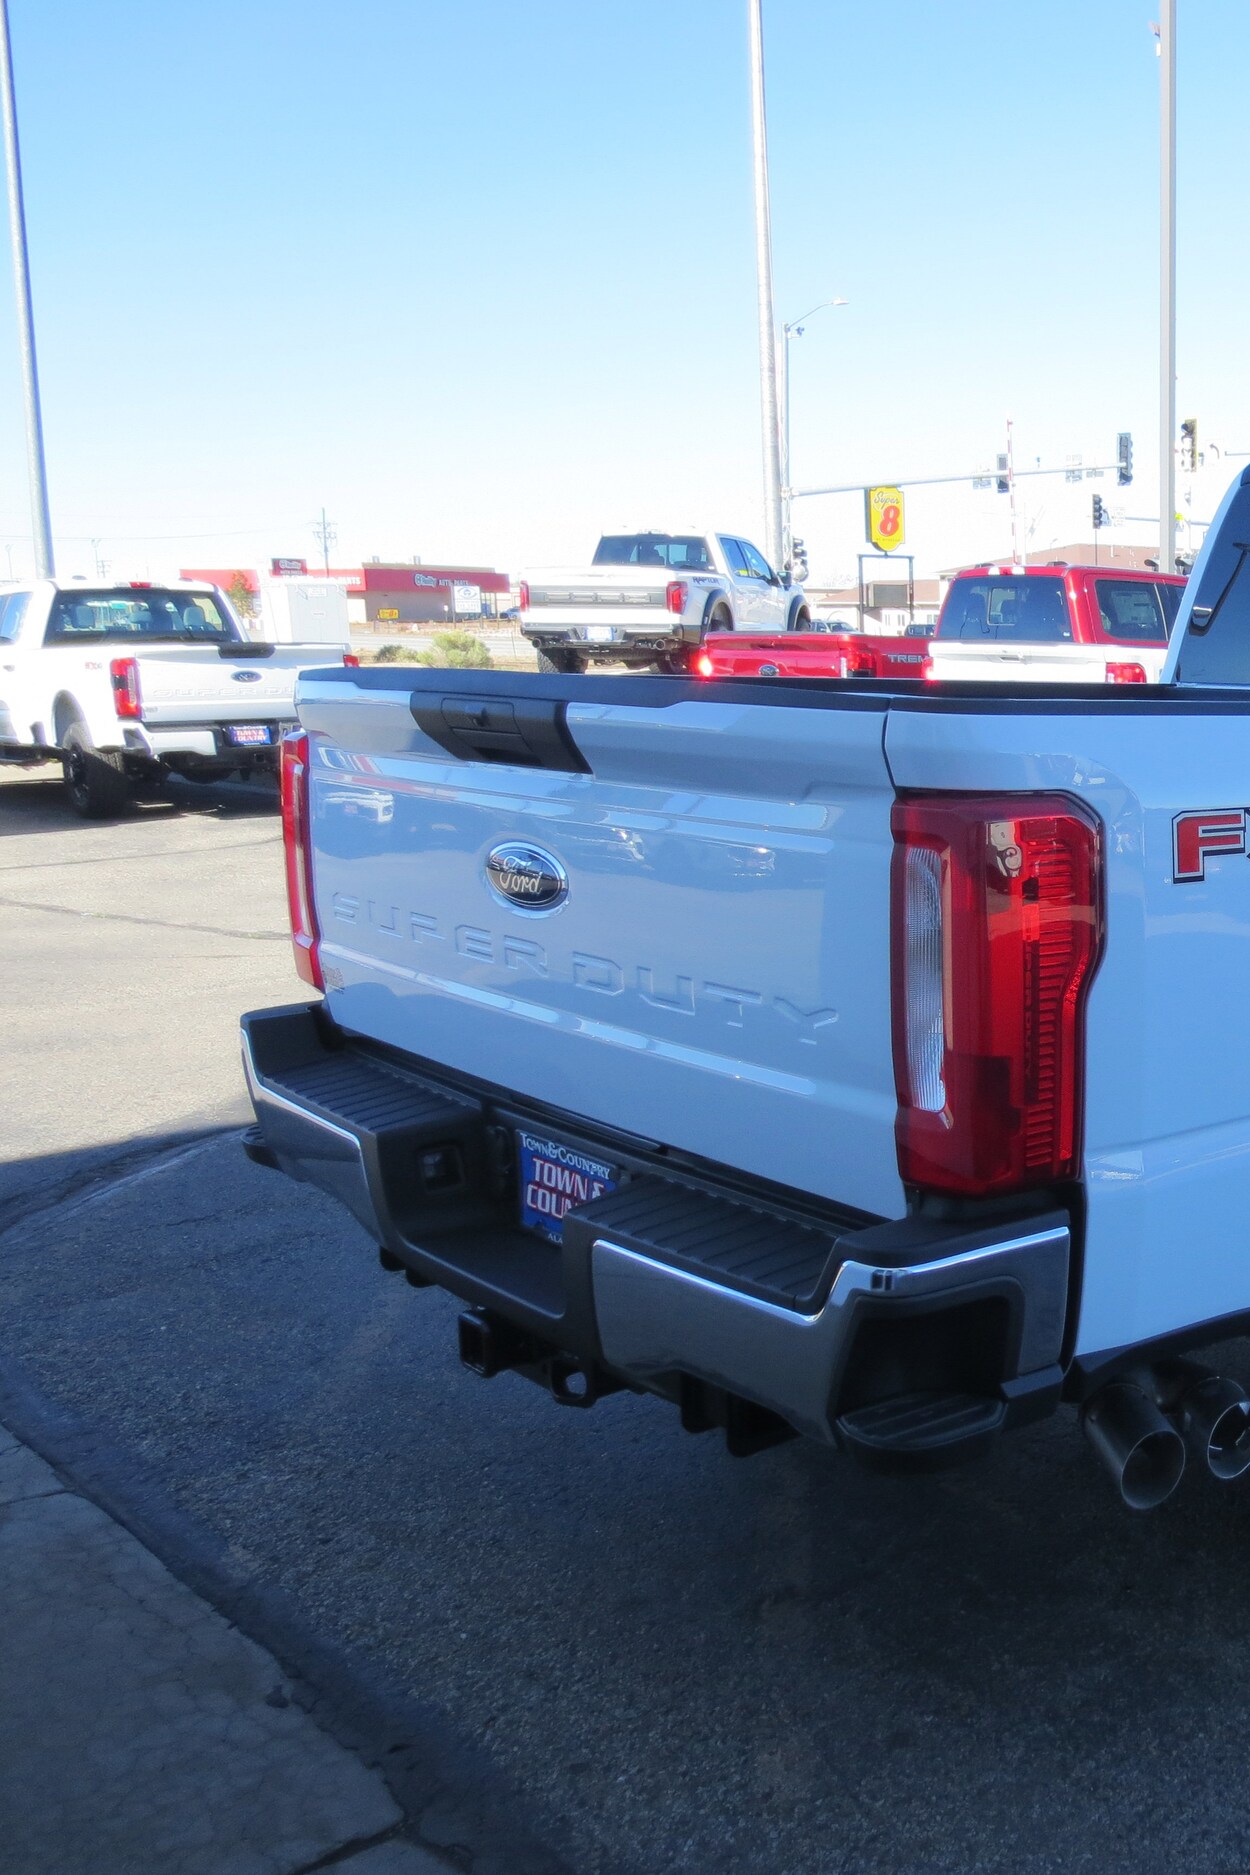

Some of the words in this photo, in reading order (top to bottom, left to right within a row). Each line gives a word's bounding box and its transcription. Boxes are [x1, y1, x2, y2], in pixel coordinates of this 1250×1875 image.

[879, 505, 900, 537] 8
[888, 654, 930, 663] TREM
[500, 855, 543, 895] Ford
[332, 891, 550, 979] SUPER
[572, 950, 839, 1045] DUTY
[532, 1157, 588, 1201] TOWN
